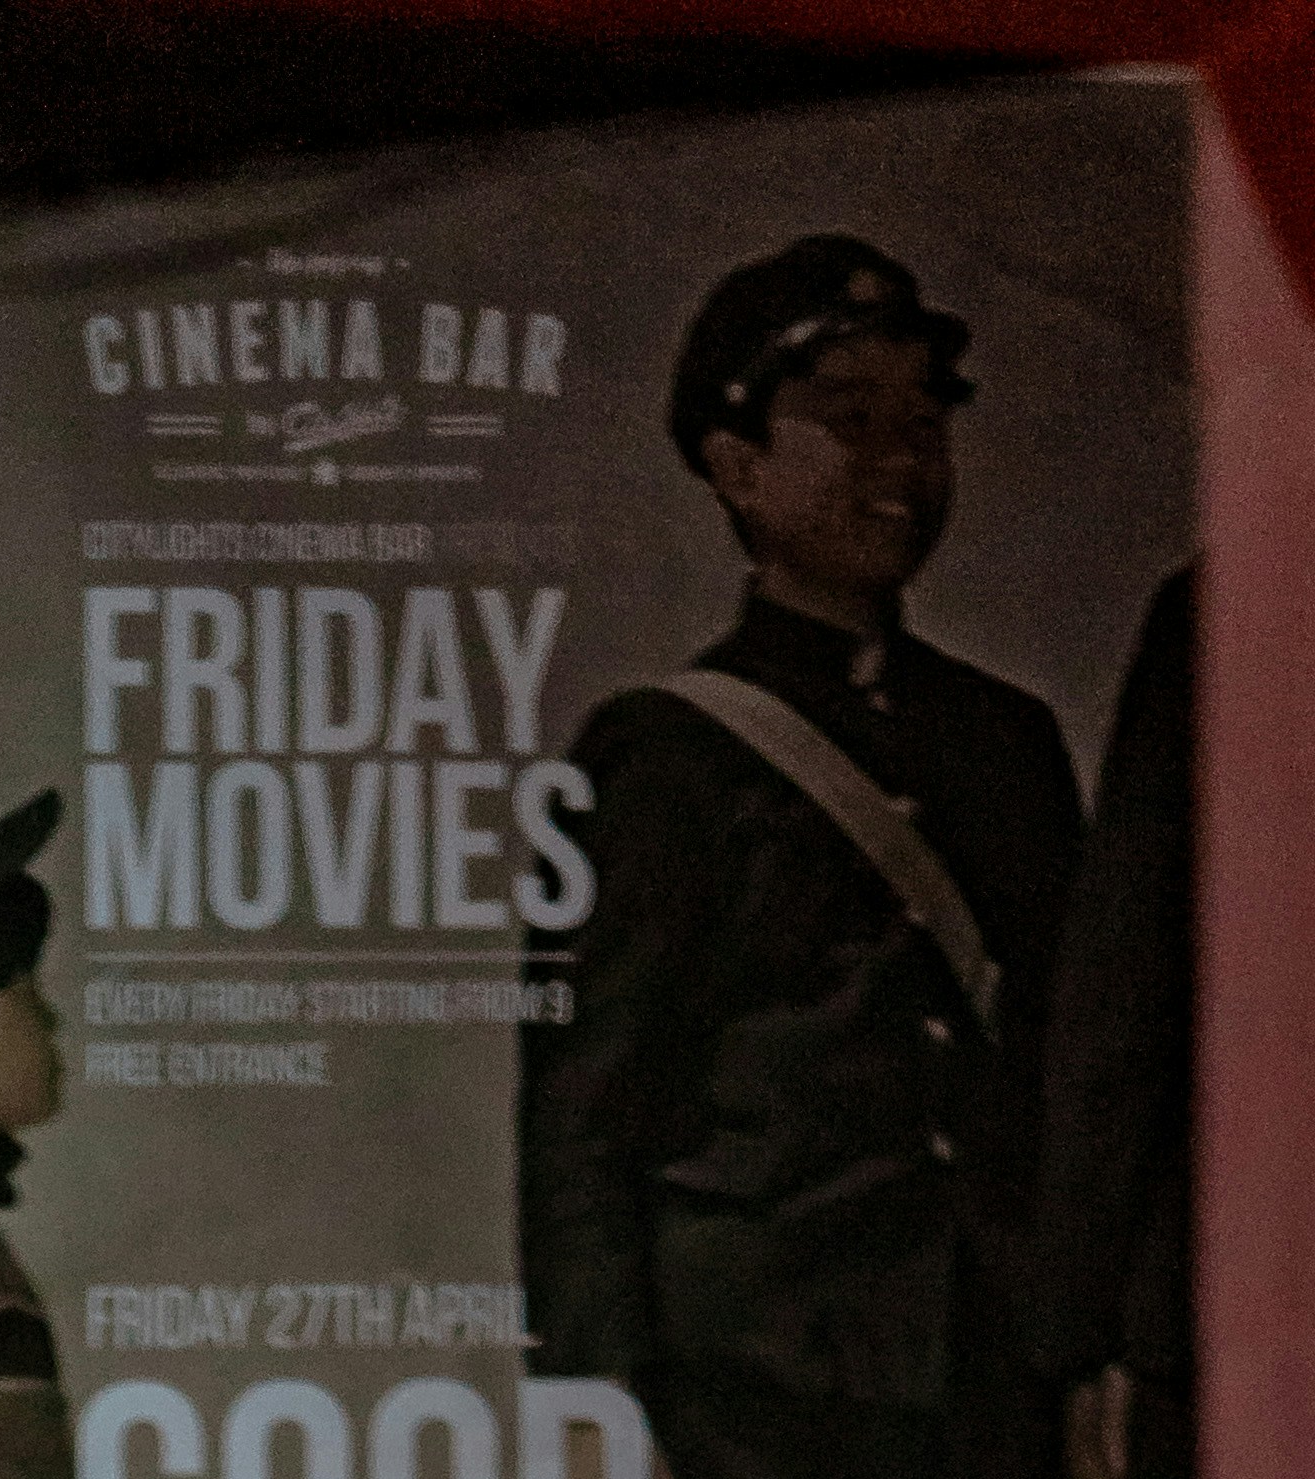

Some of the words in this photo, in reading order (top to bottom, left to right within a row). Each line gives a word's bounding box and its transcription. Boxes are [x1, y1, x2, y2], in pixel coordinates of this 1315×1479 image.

[82, 299, 384, 396] CINEMA
[419, 302, 568, 398] BAR
[82, 586, 566, 755] FRIDAY
[82, 758, 597, 931] MOVIES
[84, 1042, 161, 1086] FREE
[167, 1042, 331, 1086] ENTRANCE
[84, 1284, 256, 1349] FRIDAY
[265, 1282, 395, 1350] 27TH
[399, 1282, 543, 1349] APRIL
